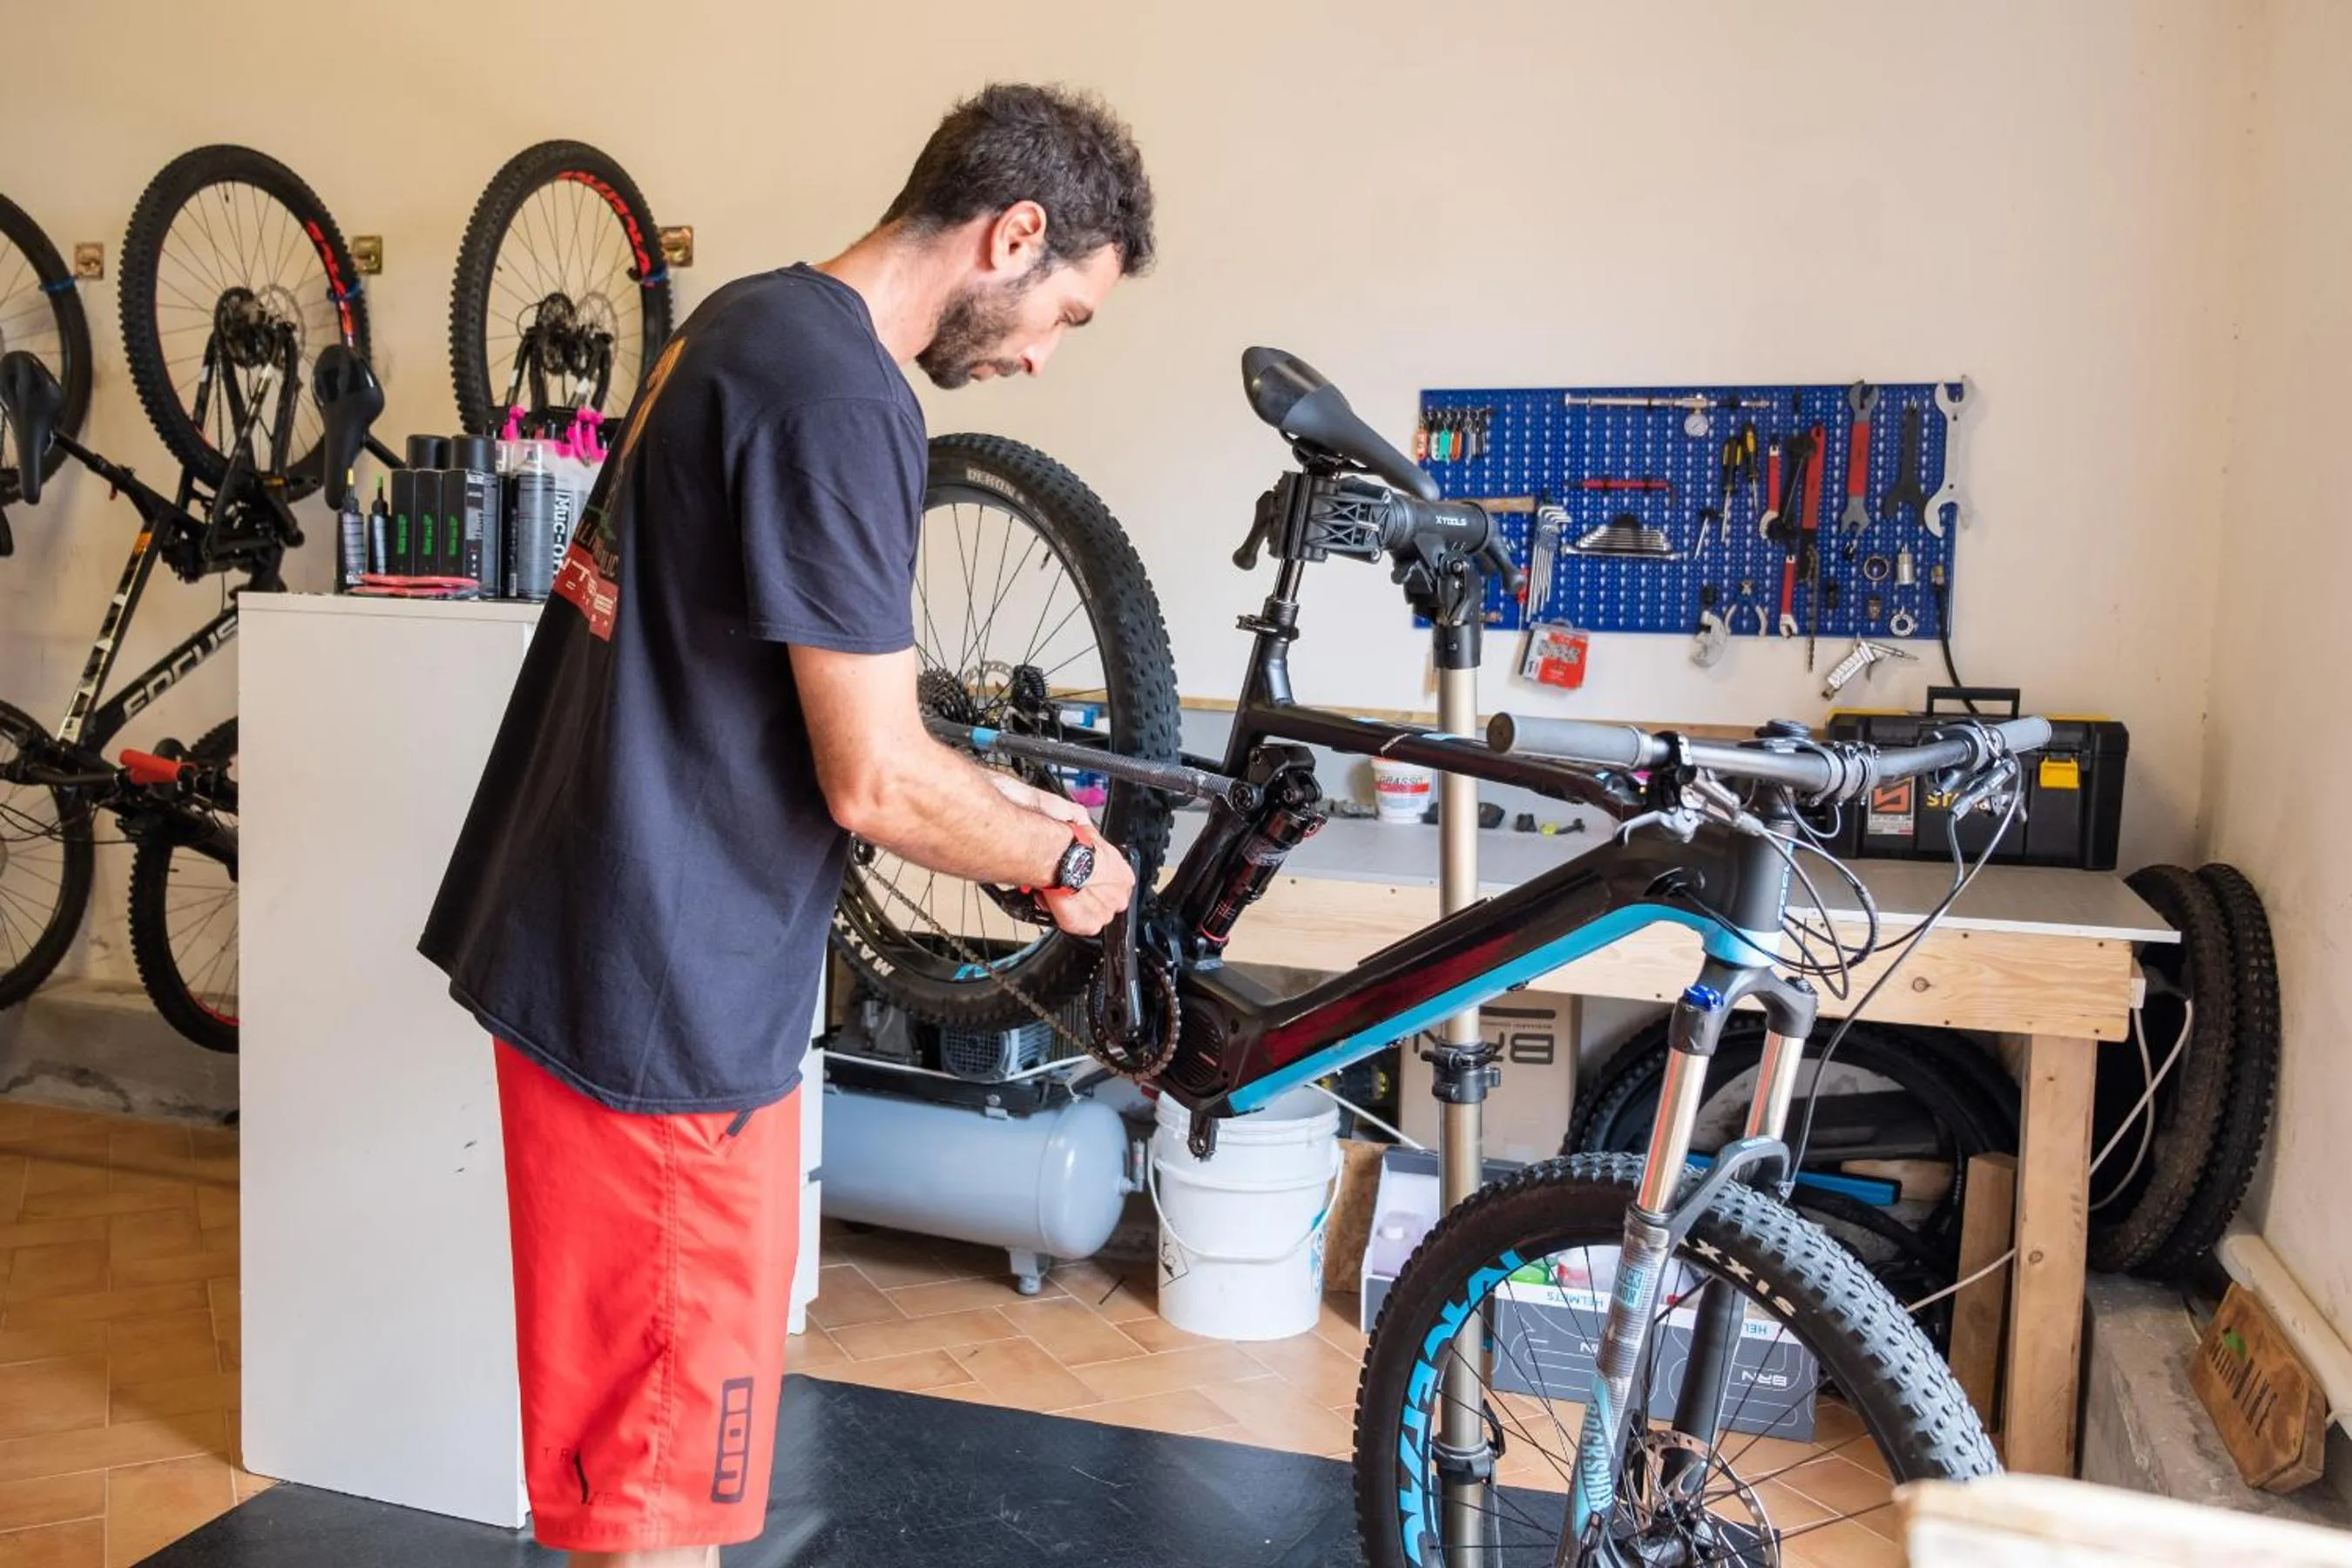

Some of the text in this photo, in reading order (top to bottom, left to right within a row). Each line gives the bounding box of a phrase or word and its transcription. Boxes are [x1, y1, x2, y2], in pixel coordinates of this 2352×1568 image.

[832, 902, 896, 977] MAXX
[1679, 1233, 1796, 1316] XXIS
[1743, 1321, 1767, 1335] HEL
